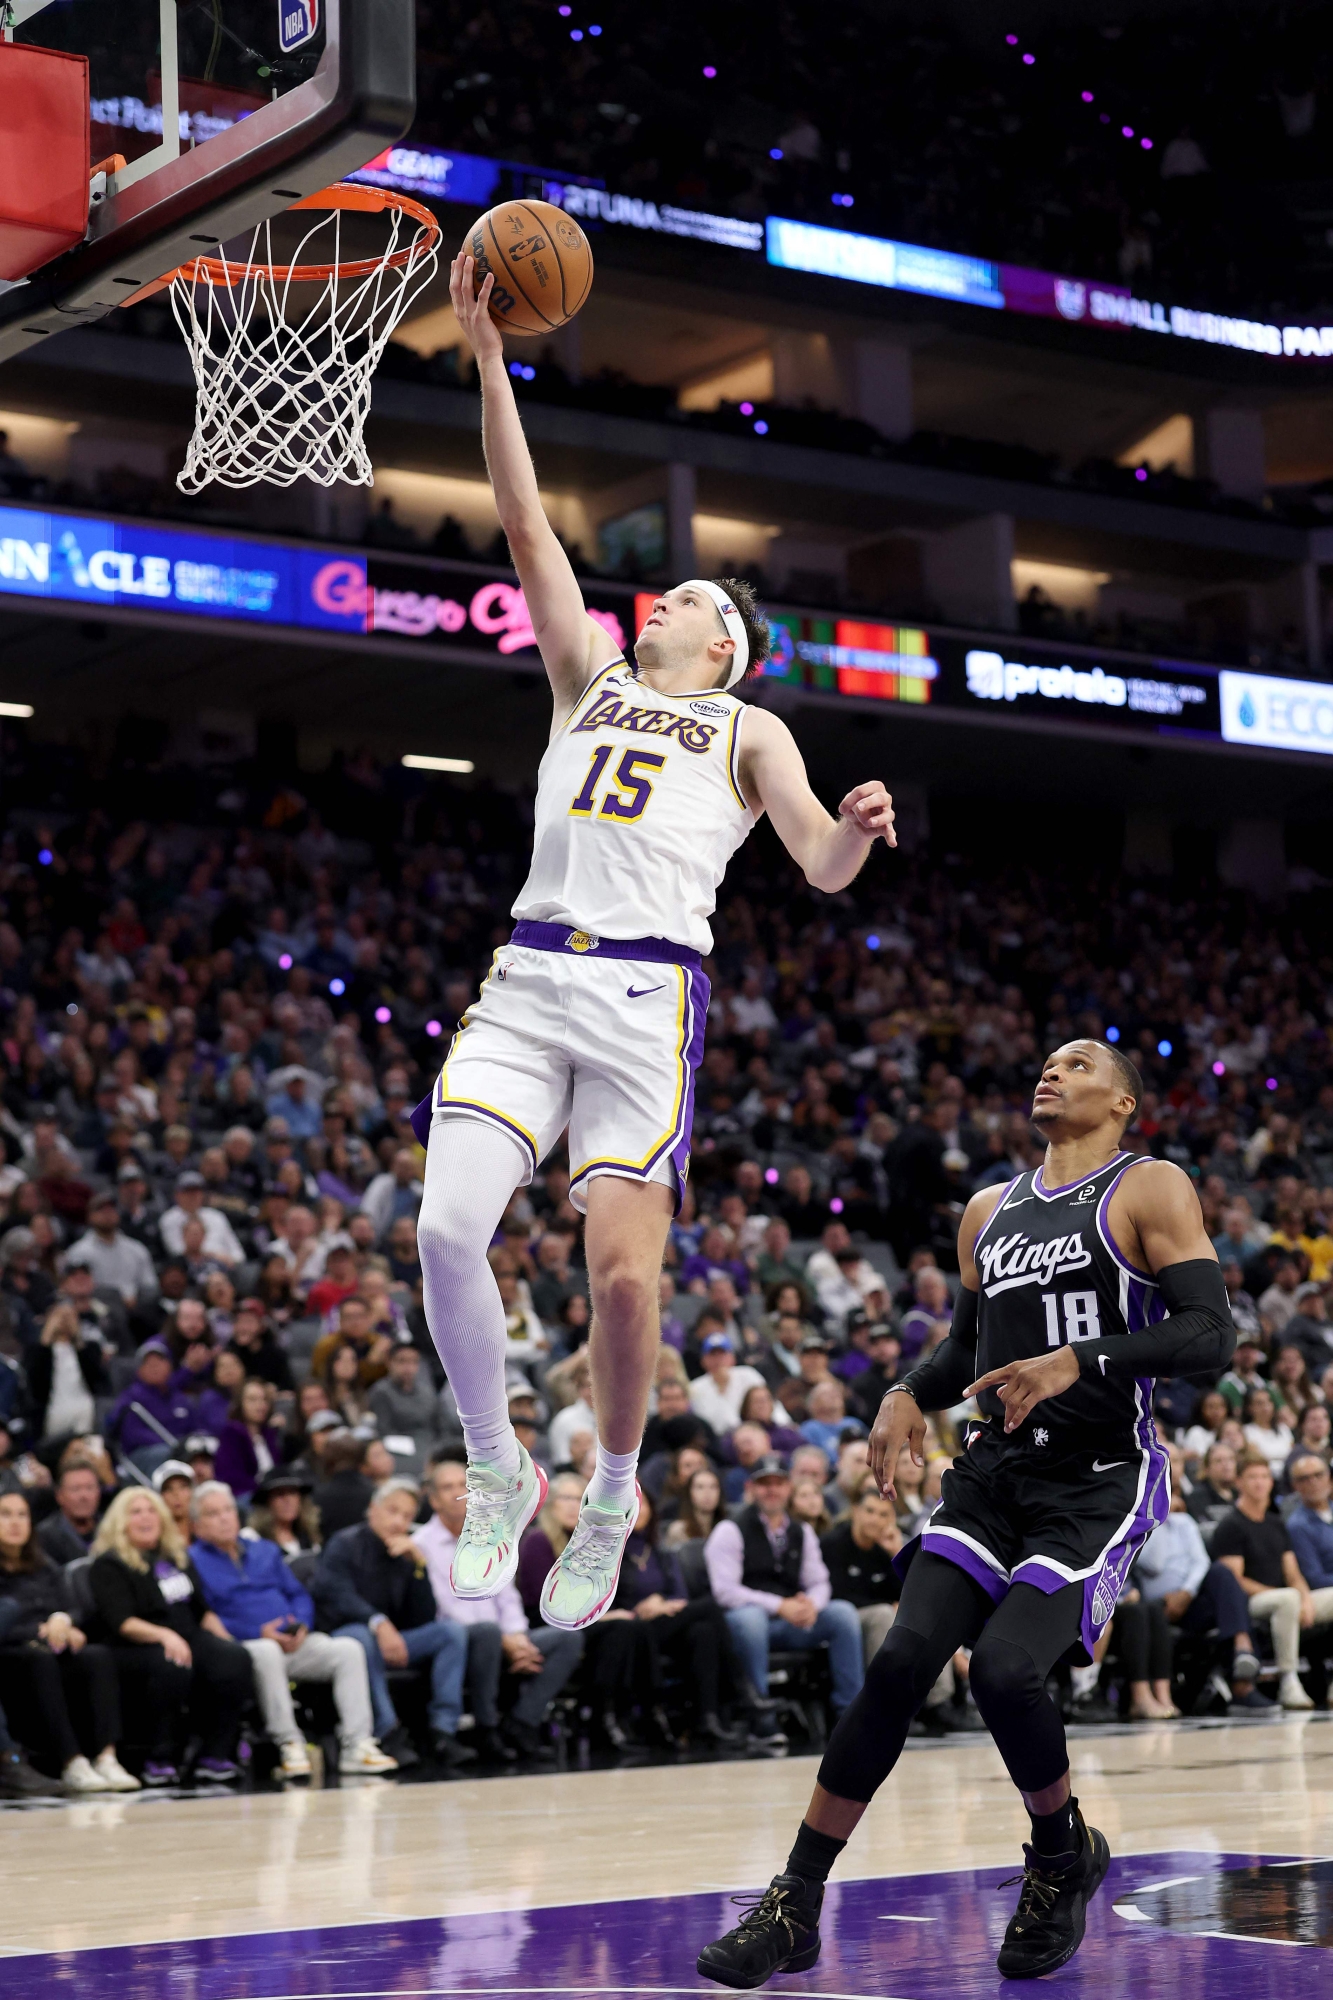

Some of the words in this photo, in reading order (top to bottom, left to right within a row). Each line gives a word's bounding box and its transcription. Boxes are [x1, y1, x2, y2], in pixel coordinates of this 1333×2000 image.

[285, 8, 303, 41] NBA
[471, 227, 516, 315] Wlson
[1170, 306, 1282, 356] BUSINESS
[570, 689, 718, 754] LAKERS
[693, 702, 728, 715] bibigo
[567, 743, 668, 825] 15
[980, 1232, 1092, 1298] Kings
[1041, 1290, 1101, 1347] 18
